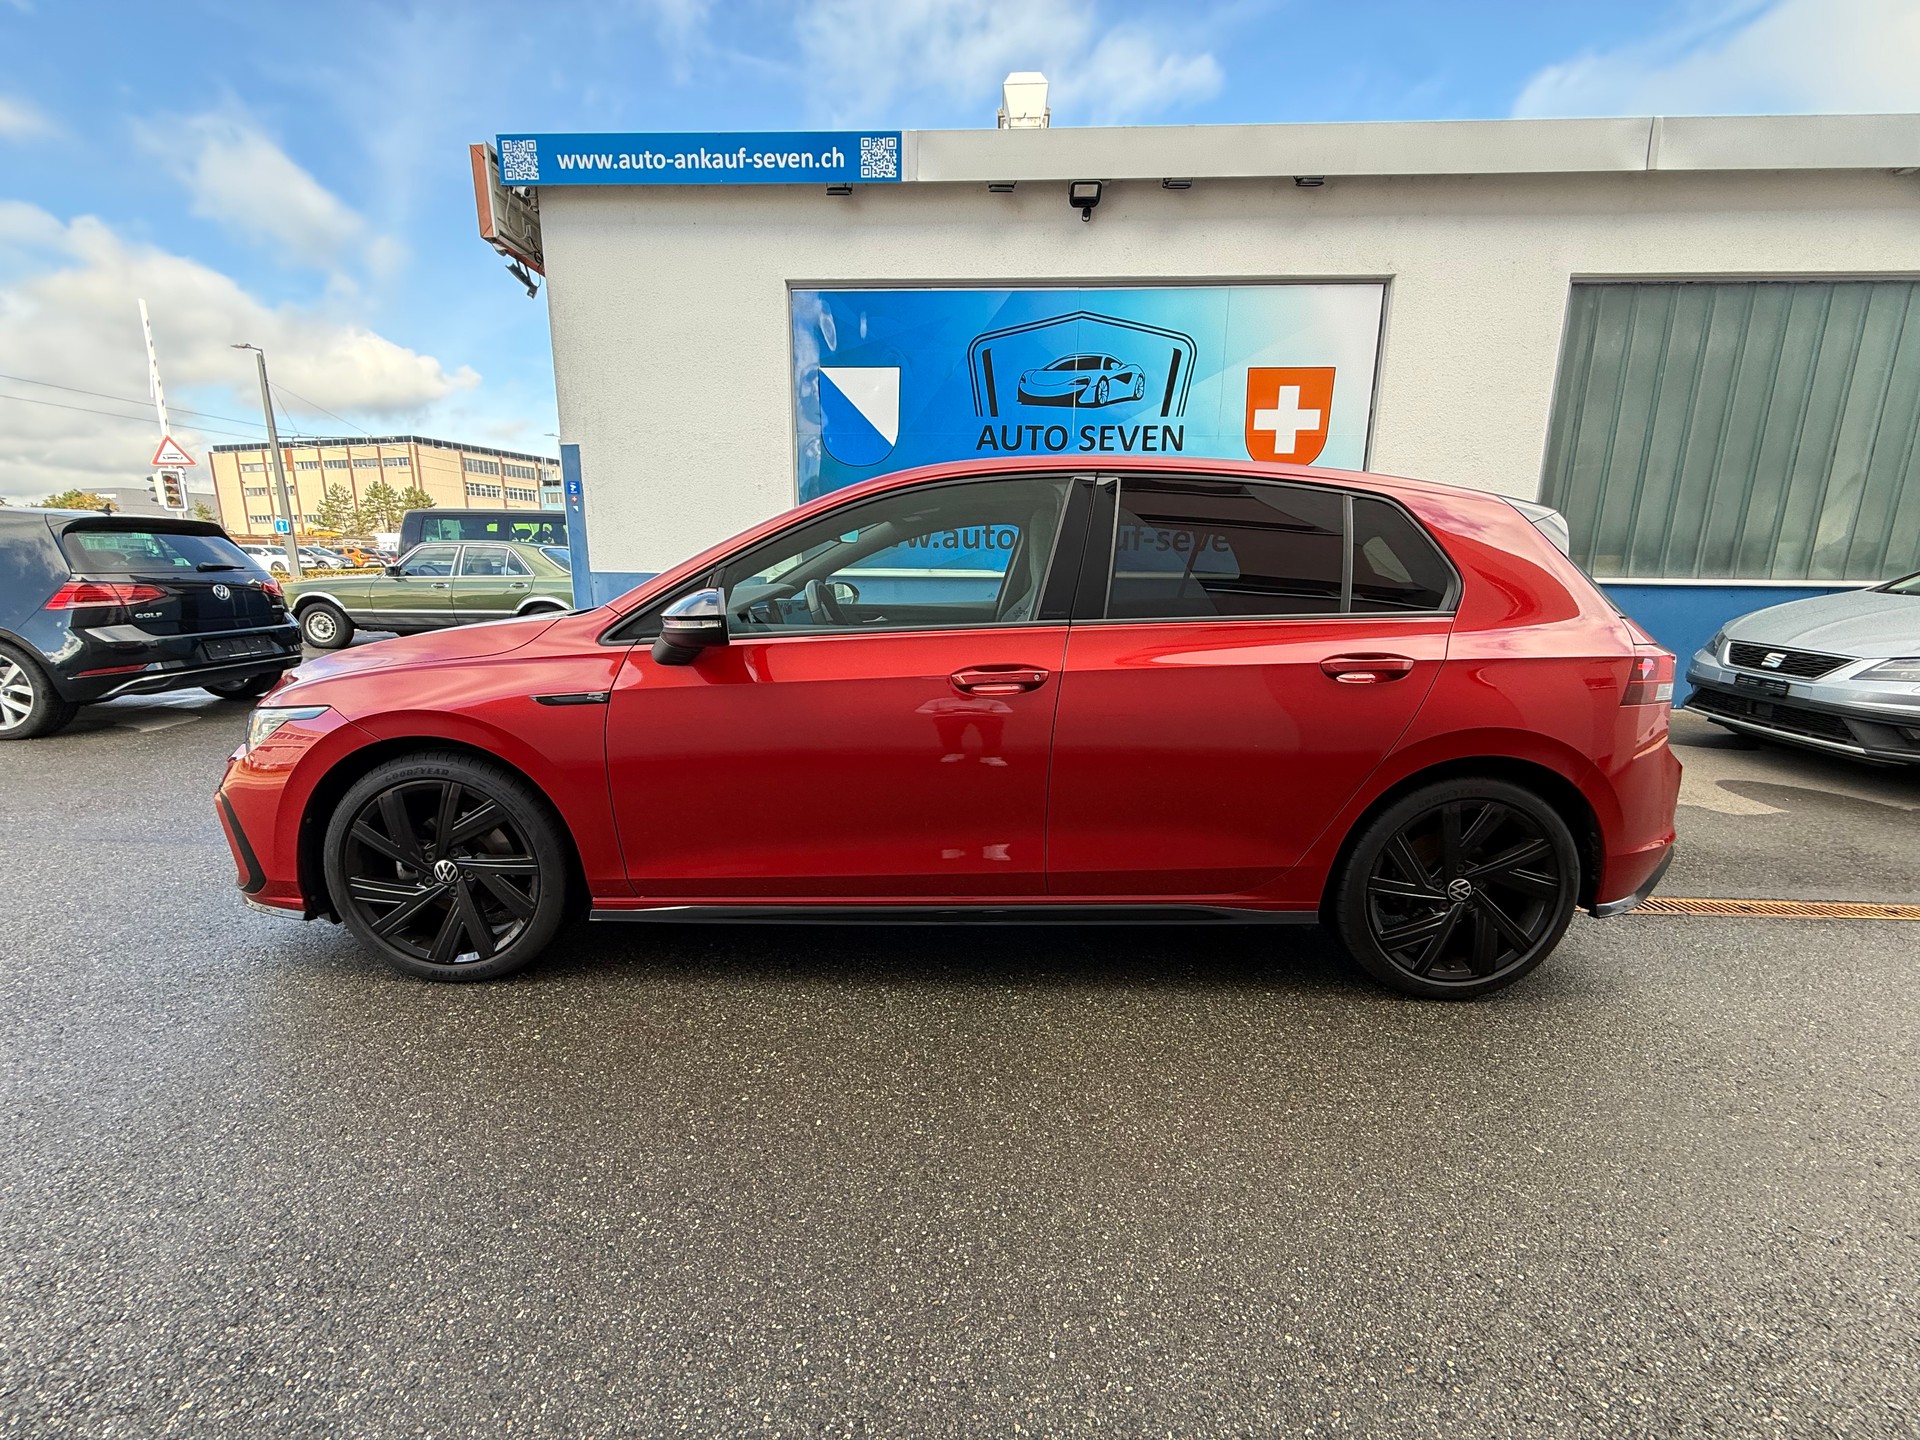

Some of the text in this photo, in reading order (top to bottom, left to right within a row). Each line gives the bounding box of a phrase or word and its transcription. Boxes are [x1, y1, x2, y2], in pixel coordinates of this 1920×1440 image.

[556, 147, 845, 171] www.auto-ankauf-seven.ch
[976, 424, 1184, 452] AUTO SEVEN
